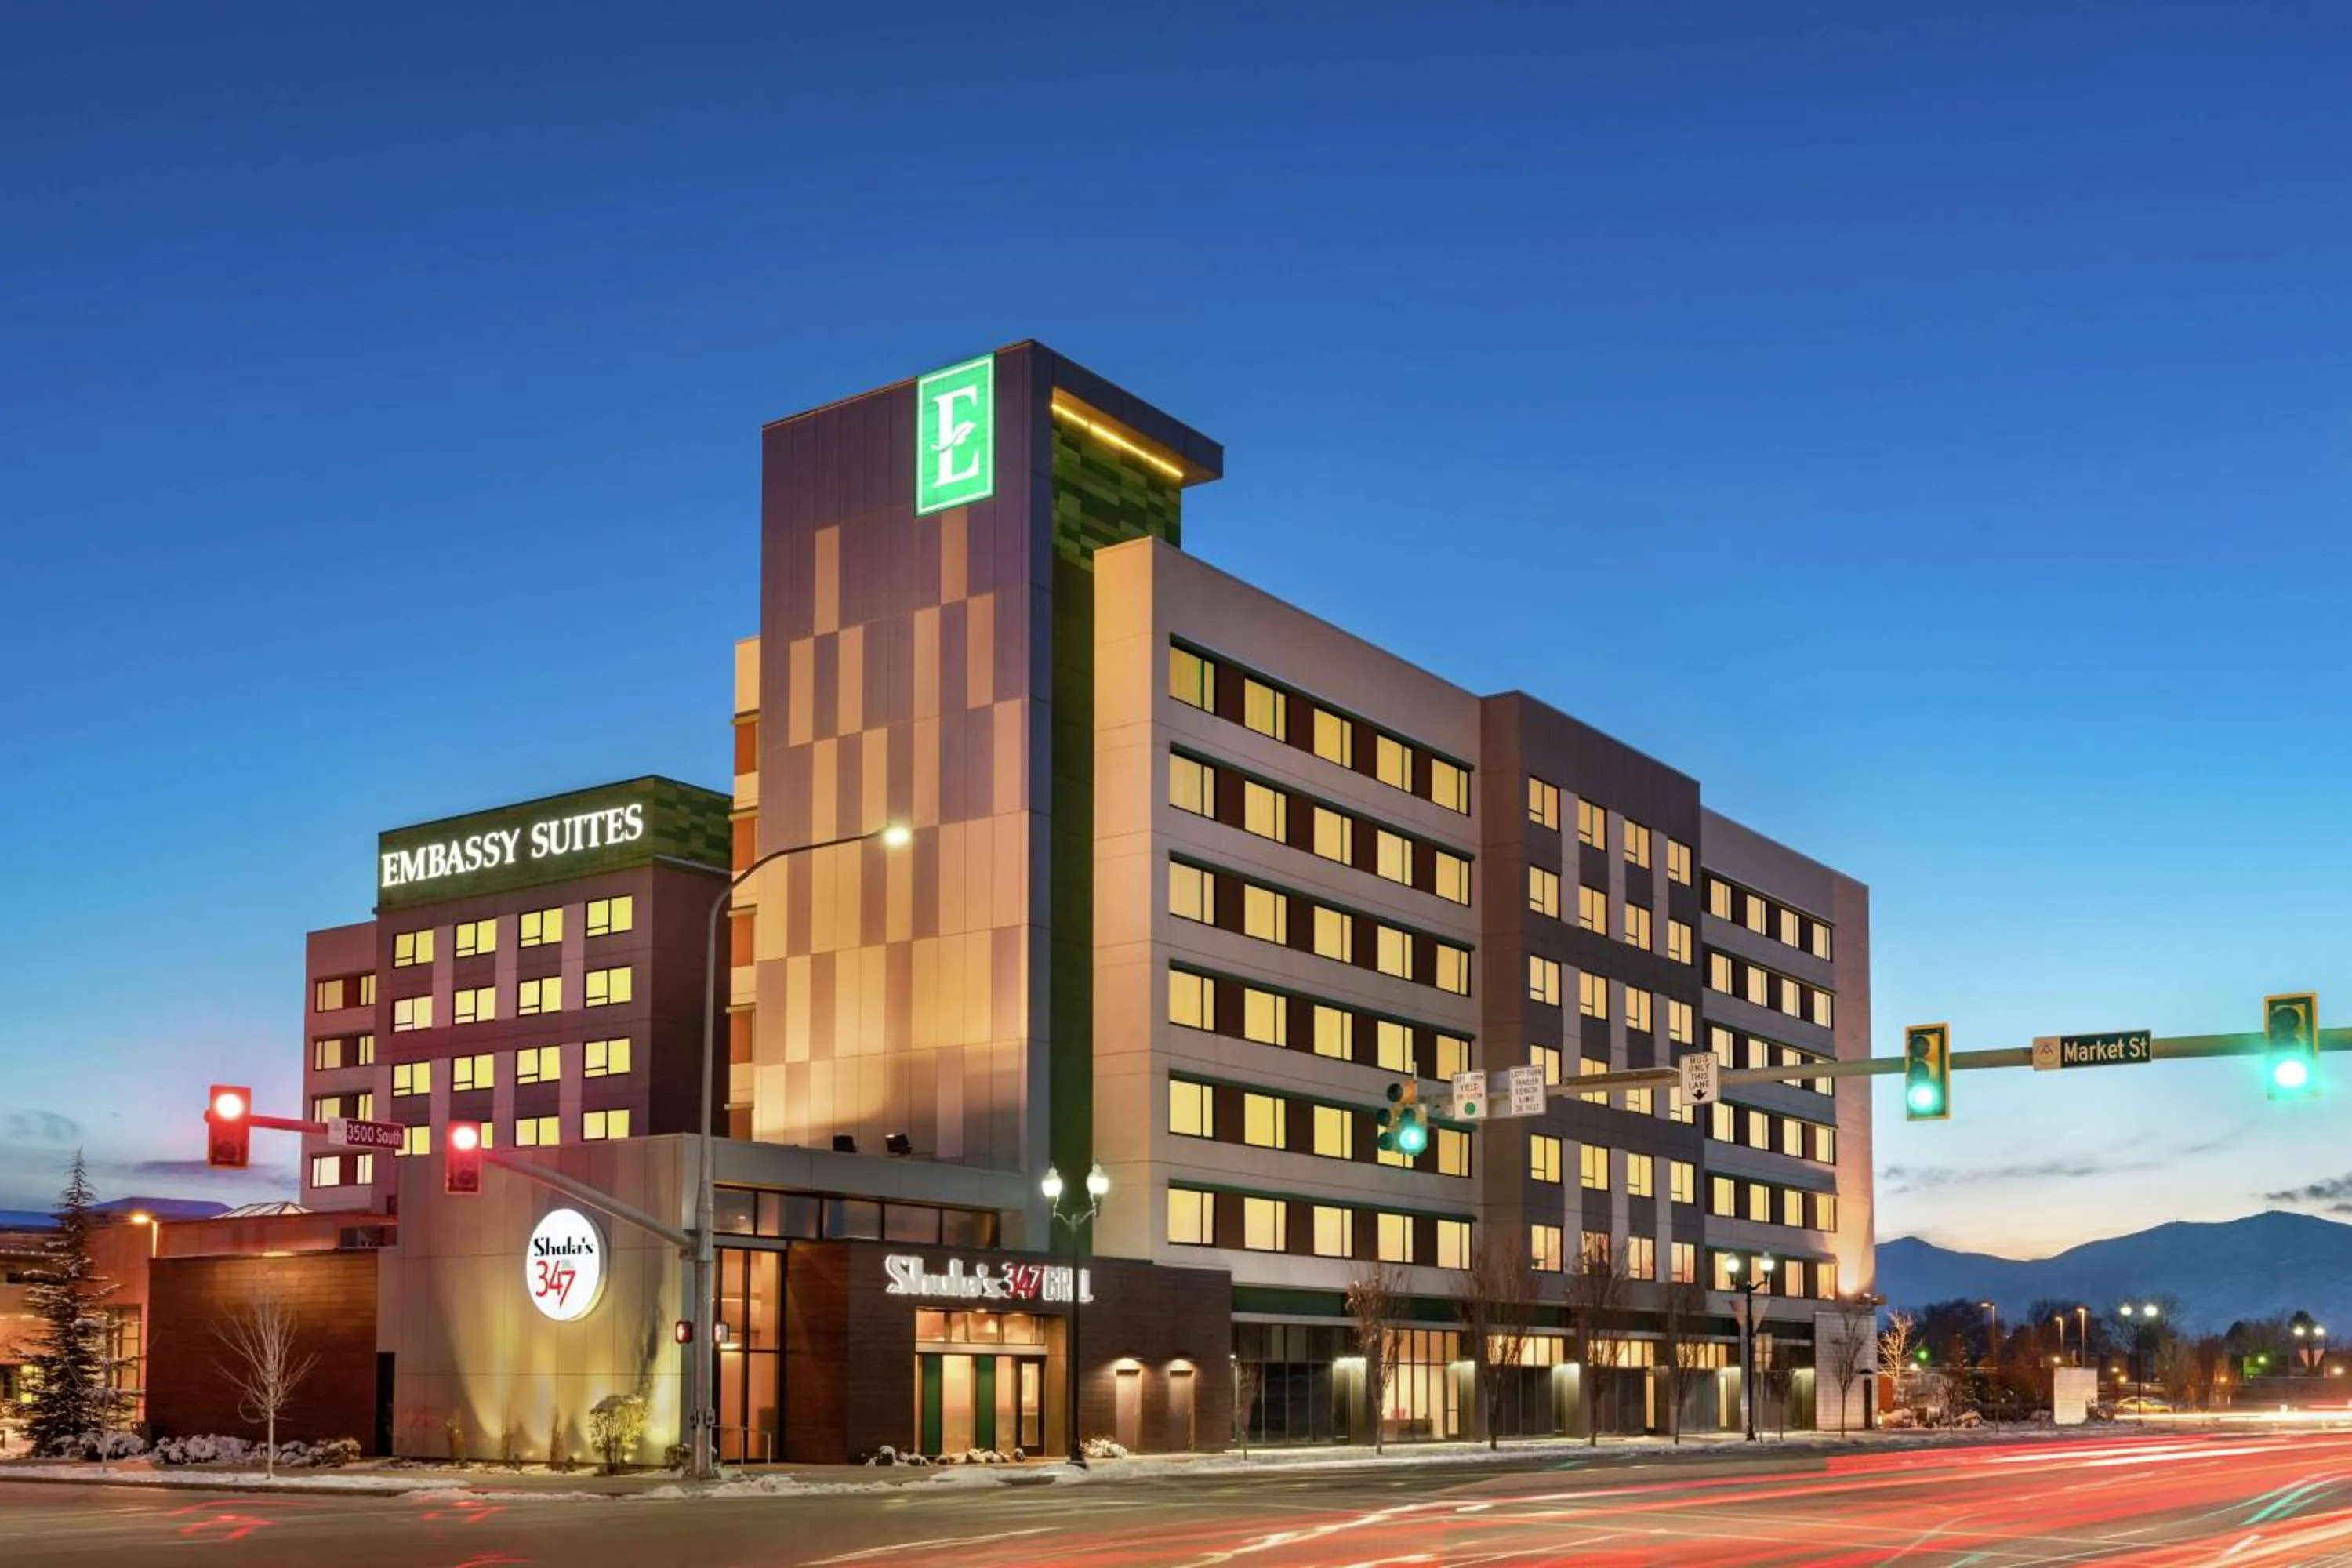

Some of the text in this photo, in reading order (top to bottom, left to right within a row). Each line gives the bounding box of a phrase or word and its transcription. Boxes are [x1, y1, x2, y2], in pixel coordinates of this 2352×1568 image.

[381, 804, 643, 887] EMBASSY SUITES
[2063, 1036, 2147, 1062] Market St
[1688, 1080, 1709, 1090] LANE
[1690, 1072, 1708, 1080] THIS
[347, 1123, 402, 1145] 3500 South
[534, 1236, 593, 1256] Shula's
[536, 1260, 575, 1308] 347
[885, 1254, 1094, 1302] Shula's 347 GRIL
